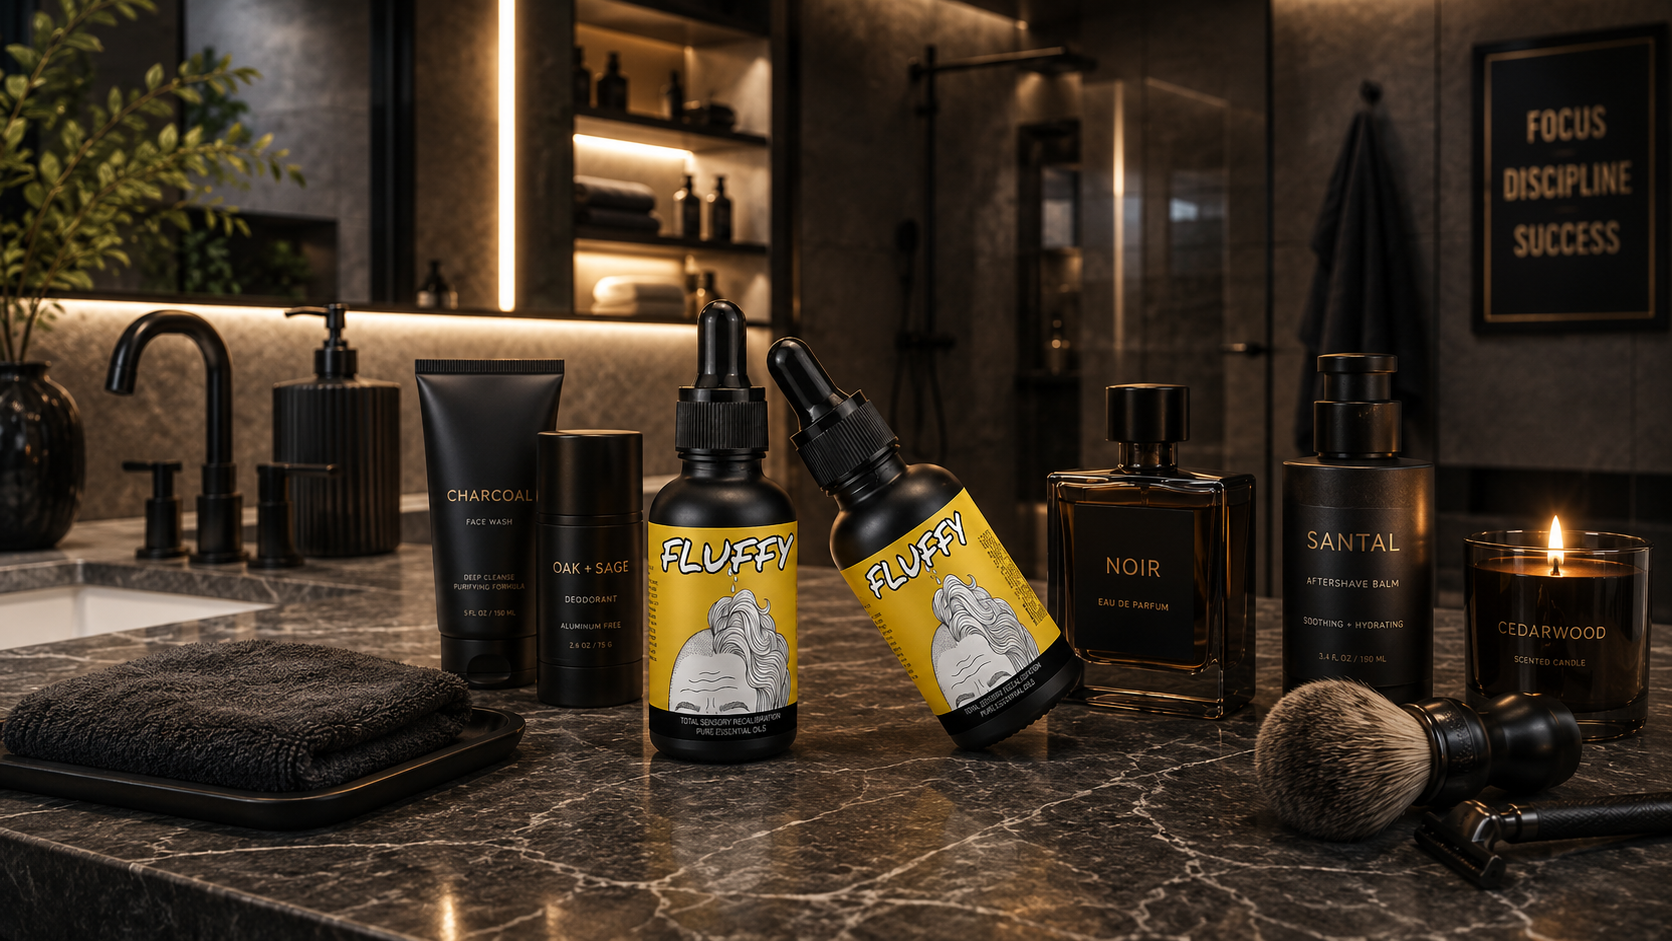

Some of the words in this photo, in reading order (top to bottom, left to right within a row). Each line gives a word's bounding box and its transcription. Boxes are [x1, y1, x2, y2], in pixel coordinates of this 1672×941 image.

[1526, 104, 1607, 144] FOCUS
[1503, 160, 1633, 201] DISCIPLINE
[1513, 219, 1621, 258] SUCCESS
[447, 489, 533, 502] CHARCOAL
[466, 518, 486, 526] FACE
[489, 518, 513, 526] WASH
[1307, 530, 1400, 552] SANTAL
[660, 532, 794, 575] FLUFFY
[865, 510, 967, 599] FLUFFY
[553, 561, 581, 574] OAK
[595, 560, 629, 574] SAGE
[1106, 556, 1161, 578] NOIR
[1306, 577, 1369, 588] AFTERSHAVE
[1372, 579, 1400, 588] BALM
[564, 595, 617, 604] DEODORANT
[1098, 598, 1115, 607] EAU
[1118, 599, 1130, 608] DE
[1132, 600, 1169, 611] PARFUM
[560, 622, 601, 630] ALUMINUM
[603, 621, 622, 629] FREE
[1303, 616, 1344, 629] SOOTHING
[1355, 620, 1404, 629] HYDRATING
[1498, 620, 1607, 640] CEDARWOOD
[581, 641, 591, 649] OZ
[1340, 654, 1352, 663] OZ
[1513, 655, 1551, 666] SCENTED
[1552, 659, 1586, 667] CANDLE
[680, 716, 699, 726] TOTAL
[700, 718, 733, 727] SENSORY
[732, 712, 781, 726] RECALIBRATION
[696, 728, 714, 736] PURE
[715, 726, 751, 736] ESSENTIAL
[752, 724, 767, 734] OILS
